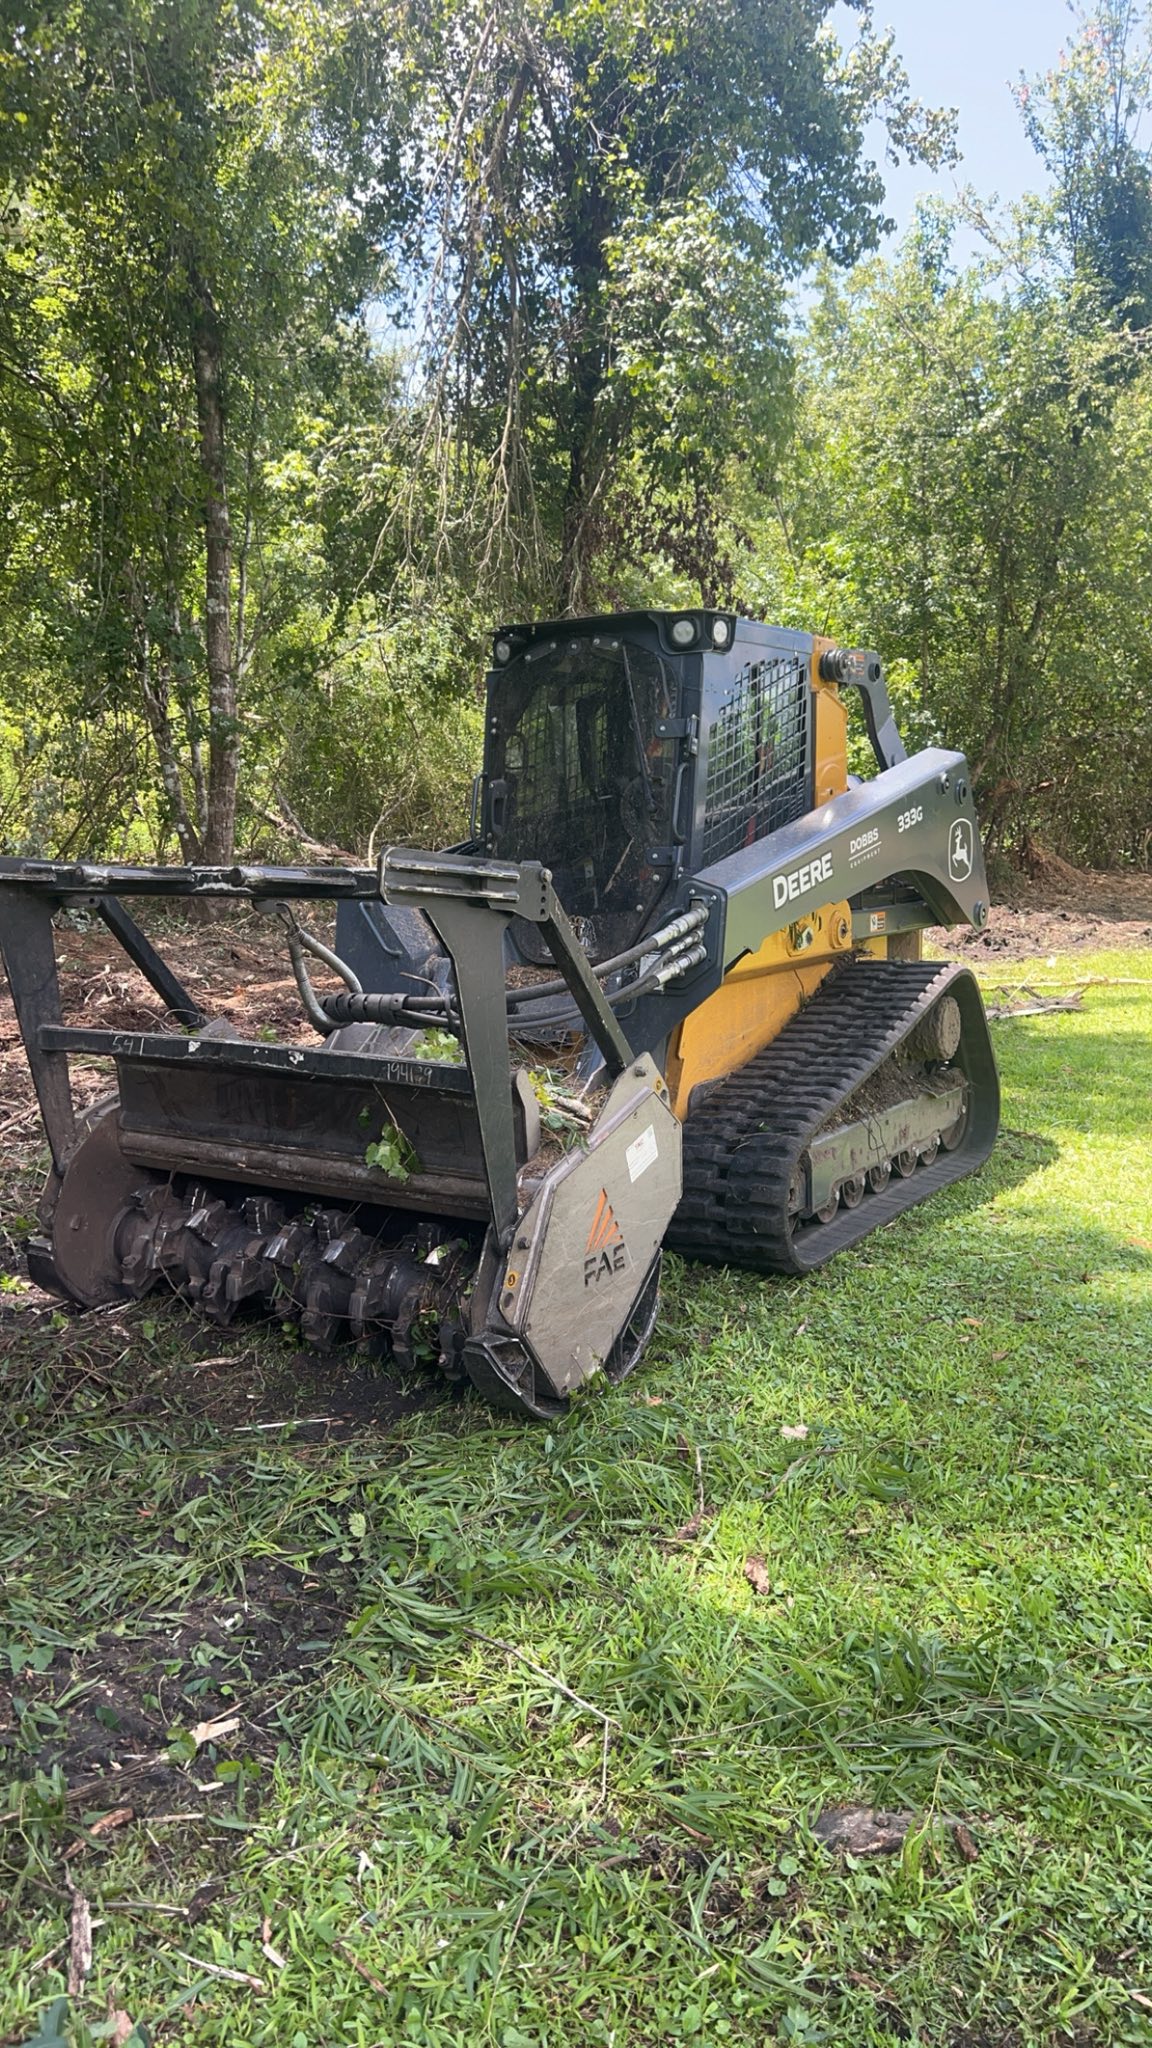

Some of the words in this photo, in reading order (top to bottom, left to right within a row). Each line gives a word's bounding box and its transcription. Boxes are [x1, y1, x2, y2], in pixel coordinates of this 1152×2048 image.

[897, 806, 924, 833] 333G
[850, 827, 879, 854] DOBBS
[772, 852, 834, 910] DEERE
[584, 1242, 625, 1288] FAE
